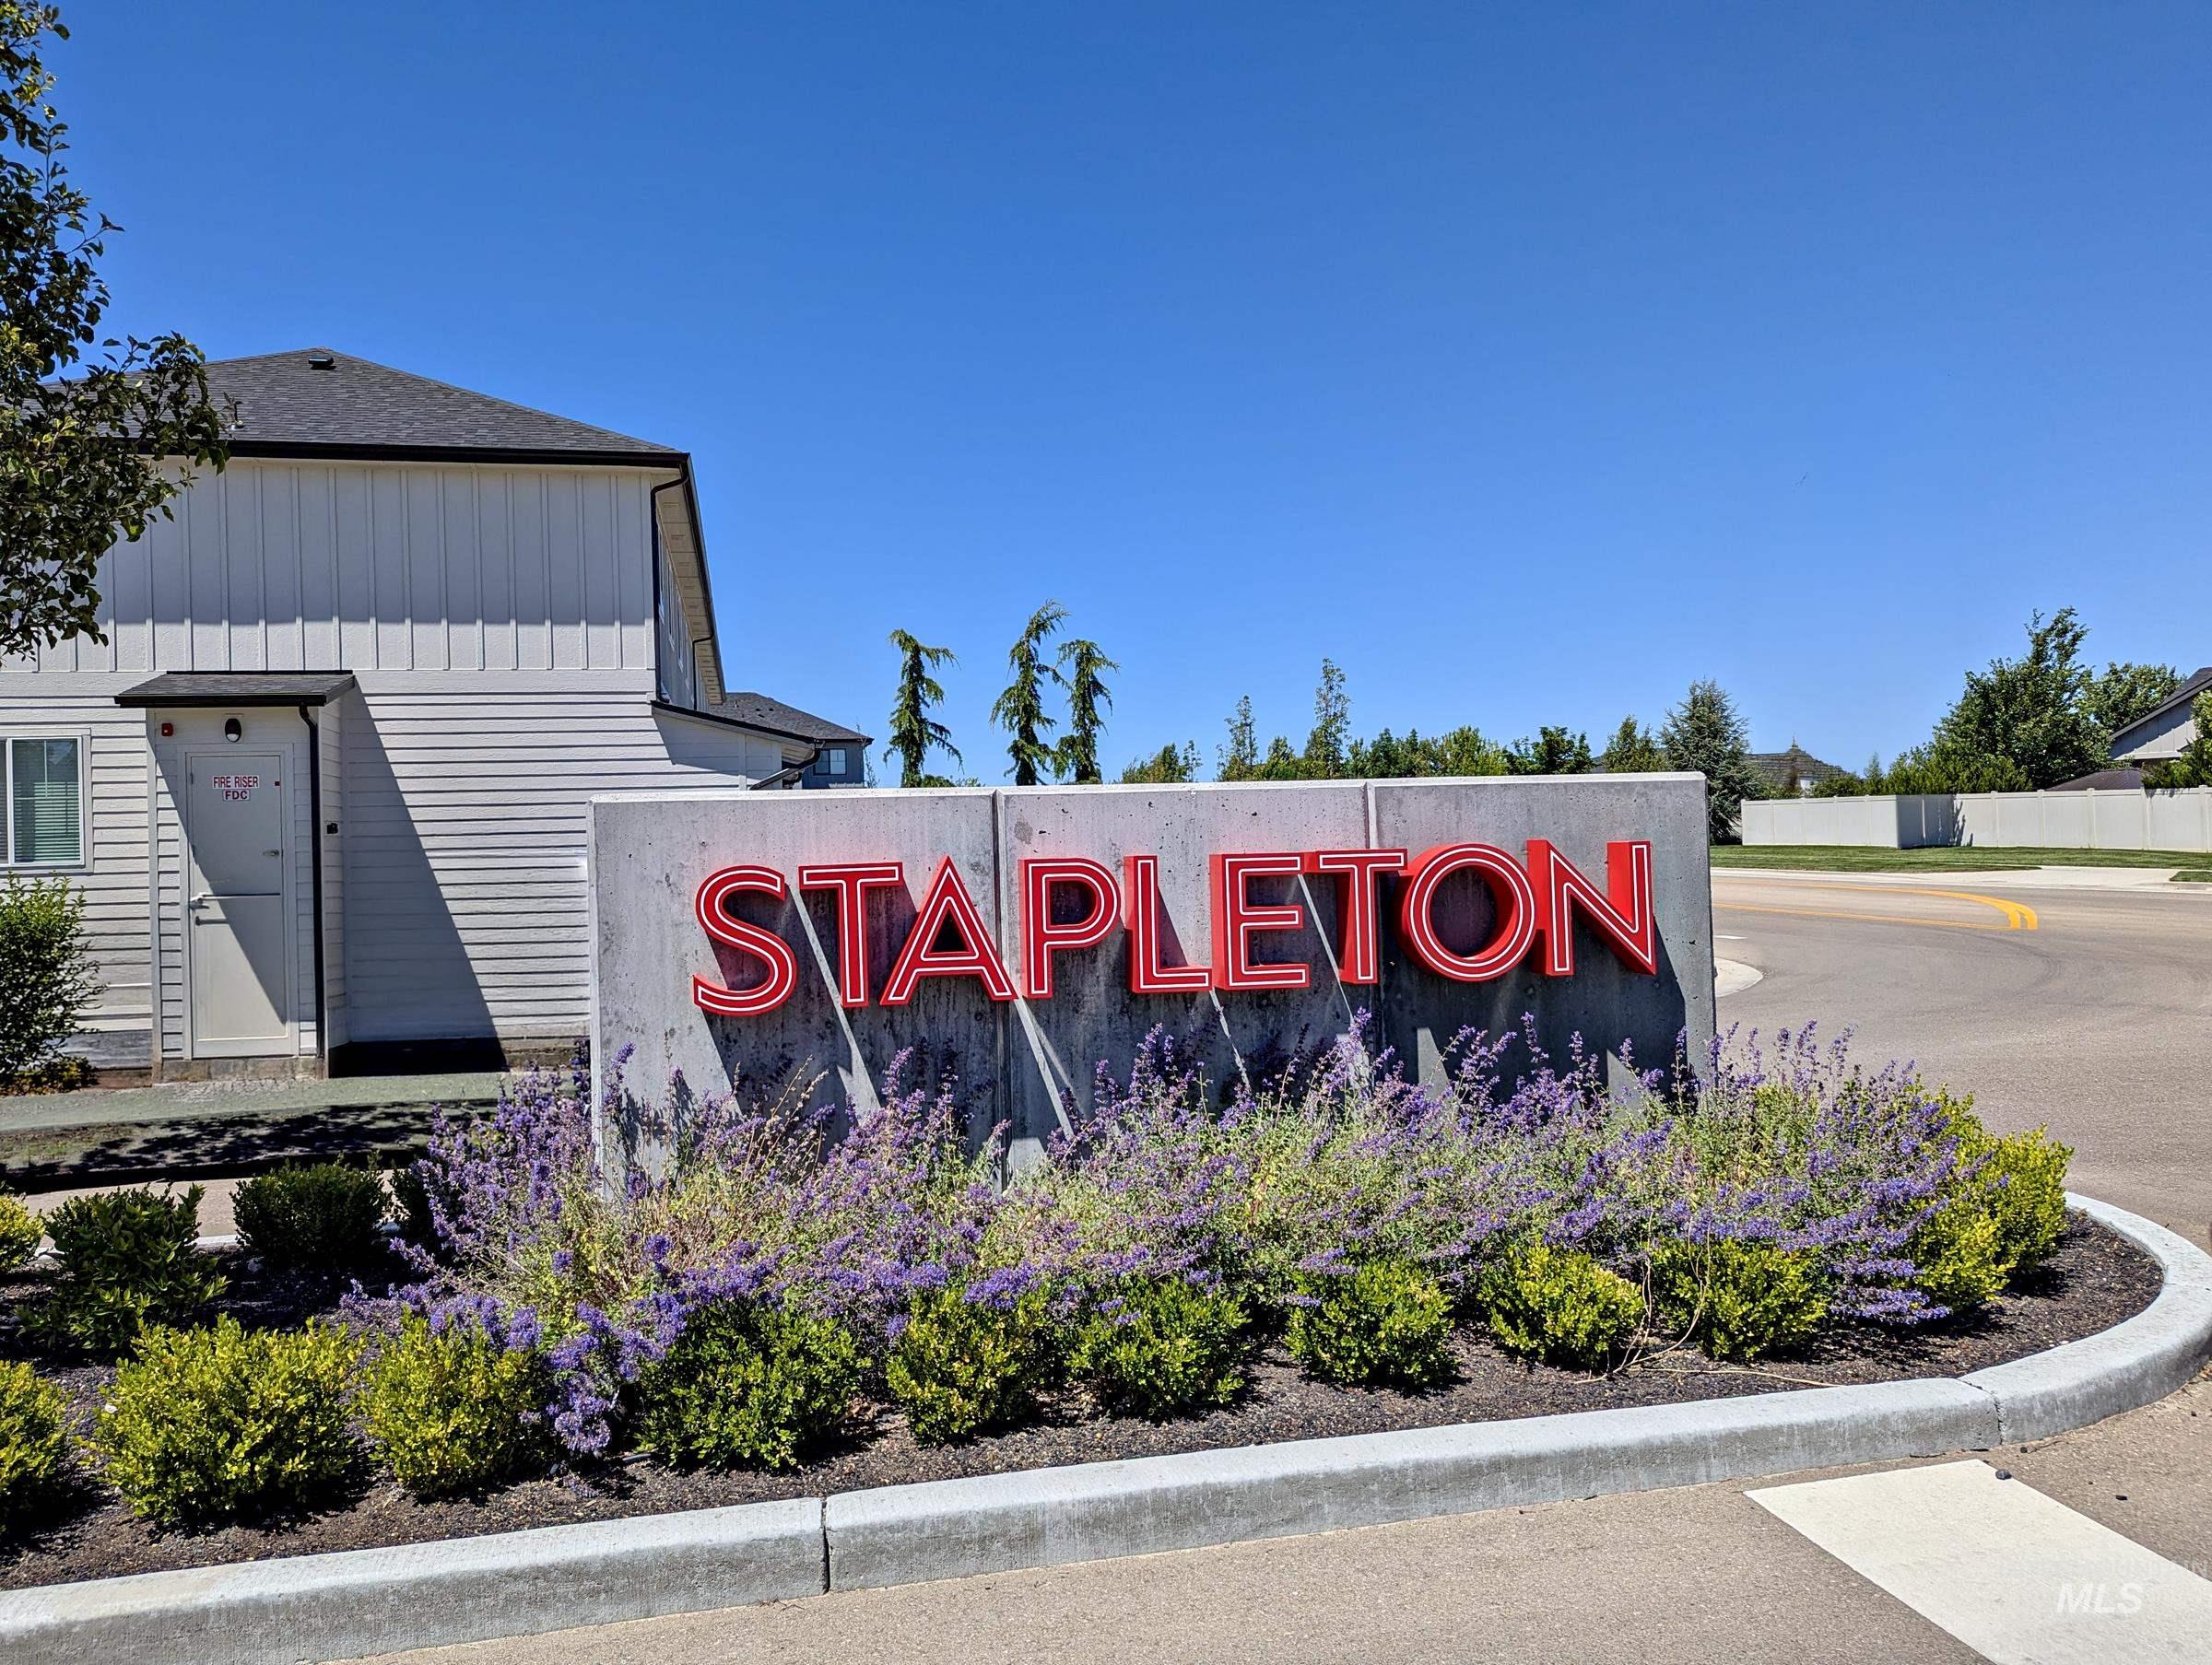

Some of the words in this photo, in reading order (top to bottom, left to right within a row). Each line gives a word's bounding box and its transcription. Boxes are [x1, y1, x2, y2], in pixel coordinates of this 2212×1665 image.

[213, 776, 231, 788] FIRE
[234, 776, 259, 788] RISER
[225, 790, 248, 800] FDC
[692, 839, 1658, 1016] STAPLETON
